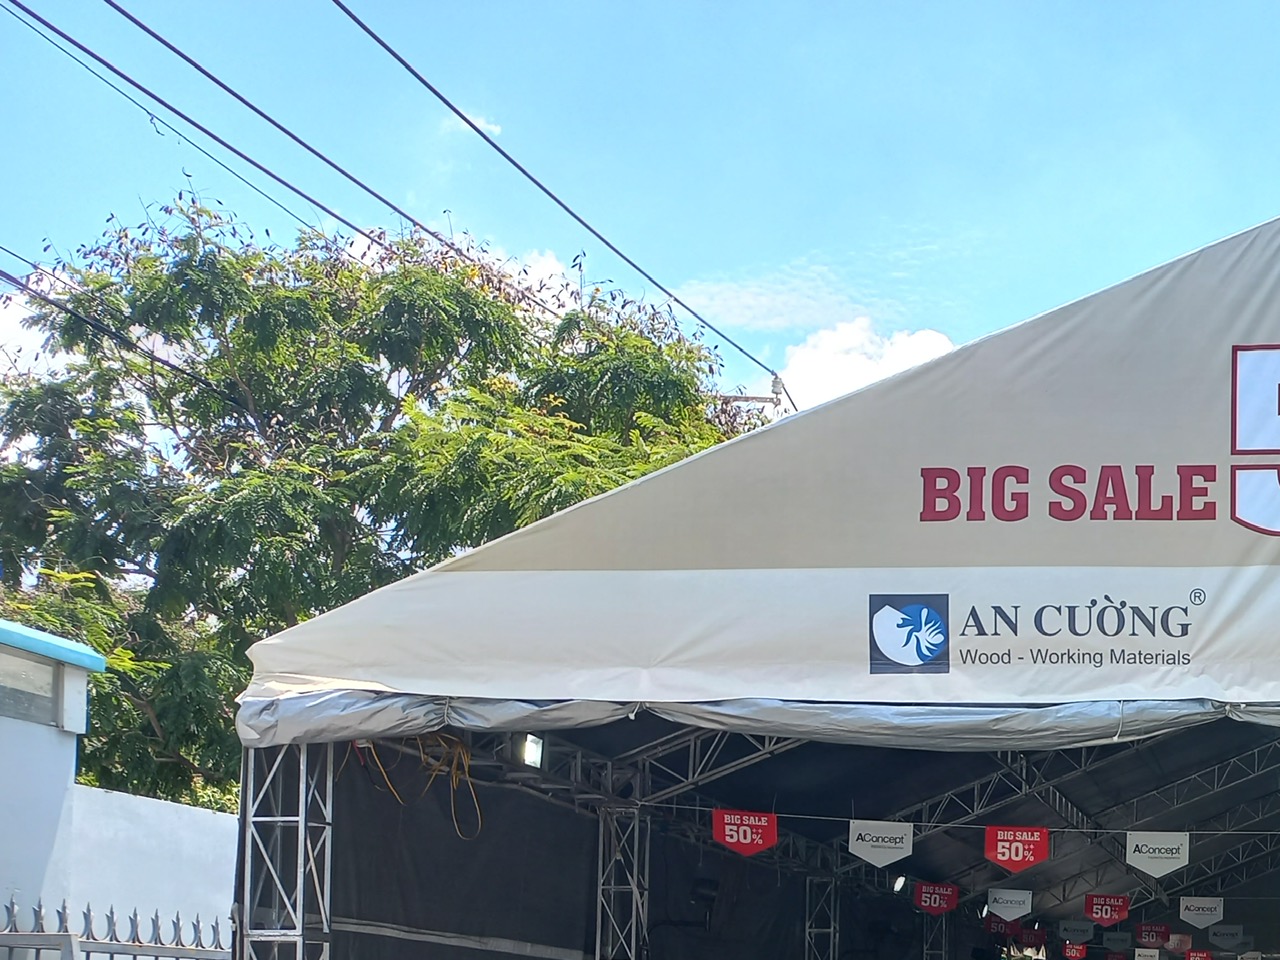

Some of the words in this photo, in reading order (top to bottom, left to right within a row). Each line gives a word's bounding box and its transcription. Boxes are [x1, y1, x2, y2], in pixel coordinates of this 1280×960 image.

[919, 466, 1030, 522] BIG
[1048, 465, 1217, 522] SALE
[959, 605, 1021, 637] AN
[1034, 594, 1193, 638] CƯỜNG
[960, 649, 1011, 665] Wood
[1030, 649, 1103, 668] Working
[1110, 649, 1191, 665] Materials
[724, 815, 741, 824] BIG
[742, 816, 768, 826] SALE
[997, 831, 1014, 840] BIG
[1015, 831, 1040, 841] SALE
